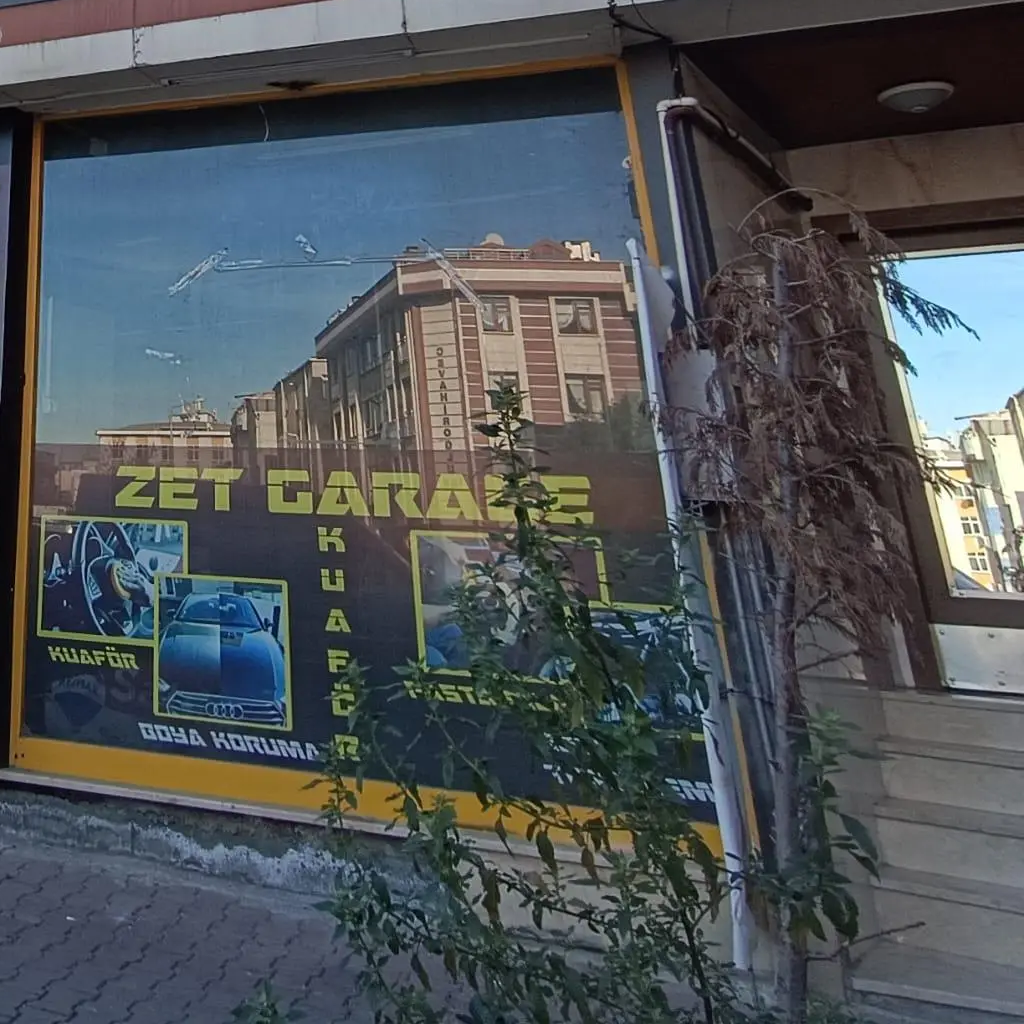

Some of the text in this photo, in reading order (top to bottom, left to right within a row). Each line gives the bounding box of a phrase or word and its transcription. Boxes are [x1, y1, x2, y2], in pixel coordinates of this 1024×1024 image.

[115, 465, 244, 511] ZET
[47, 644, 140, 671] KUAFÖR
[317, 526, 361, 762] KUAFÖR
[138, 722, 321, 762] BOYA KORUMA
